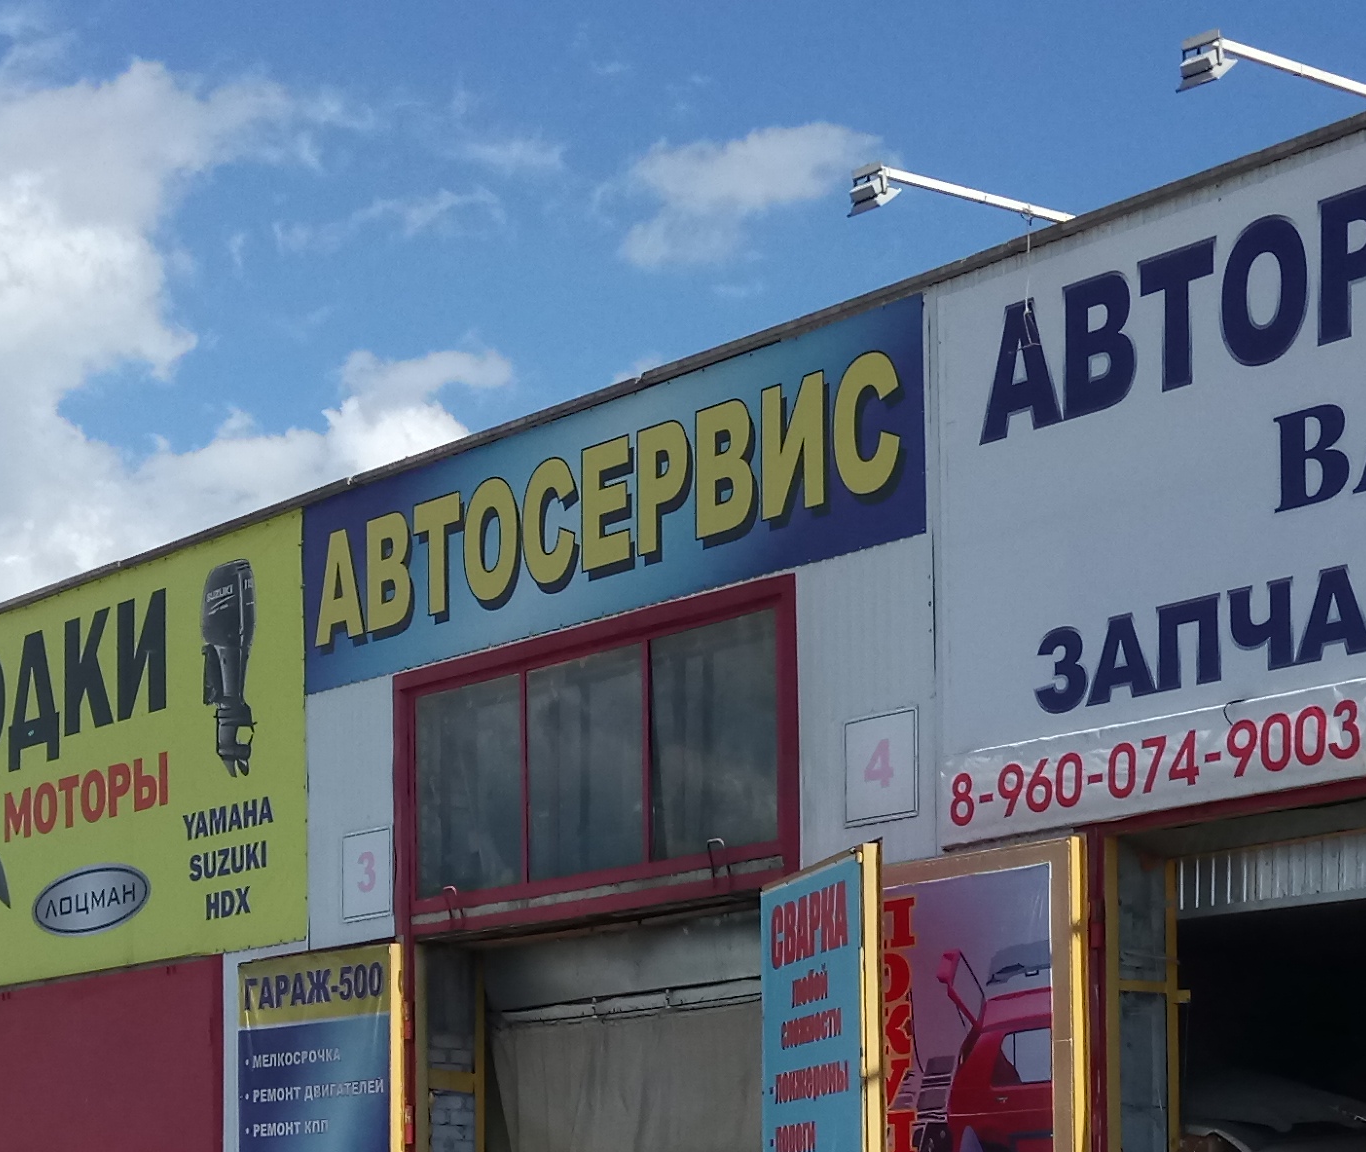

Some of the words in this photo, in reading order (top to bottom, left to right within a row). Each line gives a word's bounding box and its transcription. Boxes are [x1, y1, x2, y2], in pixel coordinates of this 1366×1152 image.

[315, 350, 902, 650] АВТОСЕРВИС
[864, 738, 895, 788] 4
[950, 699, 1361, 827] 8-960-074-9003
[4, 751, 169, 843] МОТОРЫ
[182, 797, 274, 840] YAMAHA
[189, 841, 267, 882] SUZUKI
[357, 852, 377, 893] 3
[44, 883, 136, 918] ЛОЦМАН
[205, 886, 251, 920] HDX
[771, 880, 849, 970] СВАРКА
[244, 962, 384, 1011] ГАРАЖ-500
[791, 963, 828, 1009] любой
[781, 1007, 842, 1050] сложности
[252, 1047, 341, 1069] МЕЛКОСРОЧКА
[252, 1086, 301, 1102] РЕМОНТ
[304, 1077, 384, 1101] ДВИГАТЕЛЕЙ
[252, 1121, 301, 1137] РЕМОНТ
[305, 1119, 329, 1133] КПП
